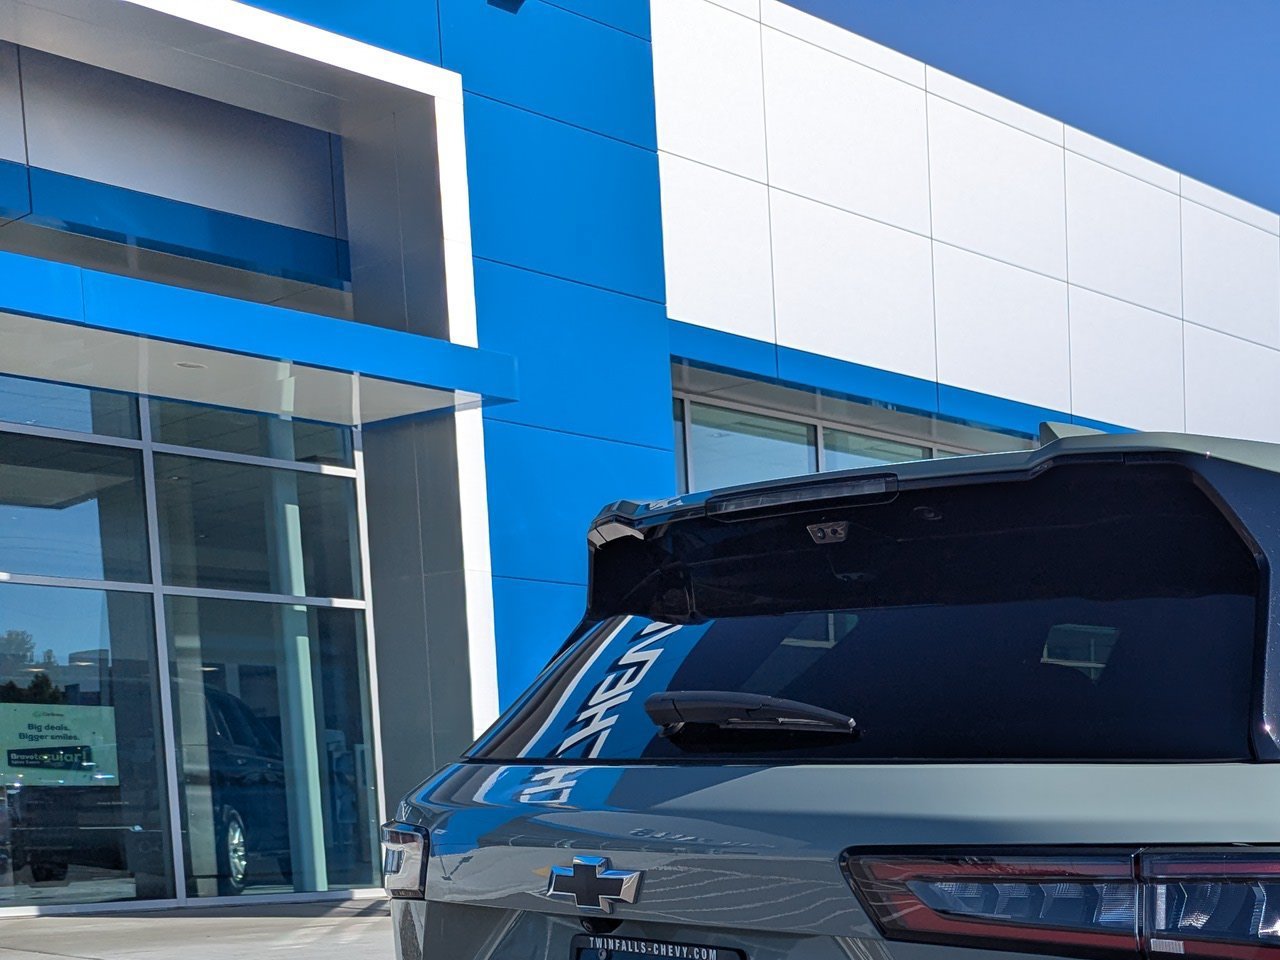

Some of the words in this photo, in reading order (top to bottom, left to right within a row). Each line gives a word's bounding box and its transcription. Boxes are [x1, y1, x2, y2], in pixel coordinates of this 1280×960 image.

[27, 723, 42, 732] Big
[44, 723, 71, 731] deals.
[18, 732, 49, 741] Bigger
[589, 937, 717, 960] TWINFALLS-CHEVY.COM
